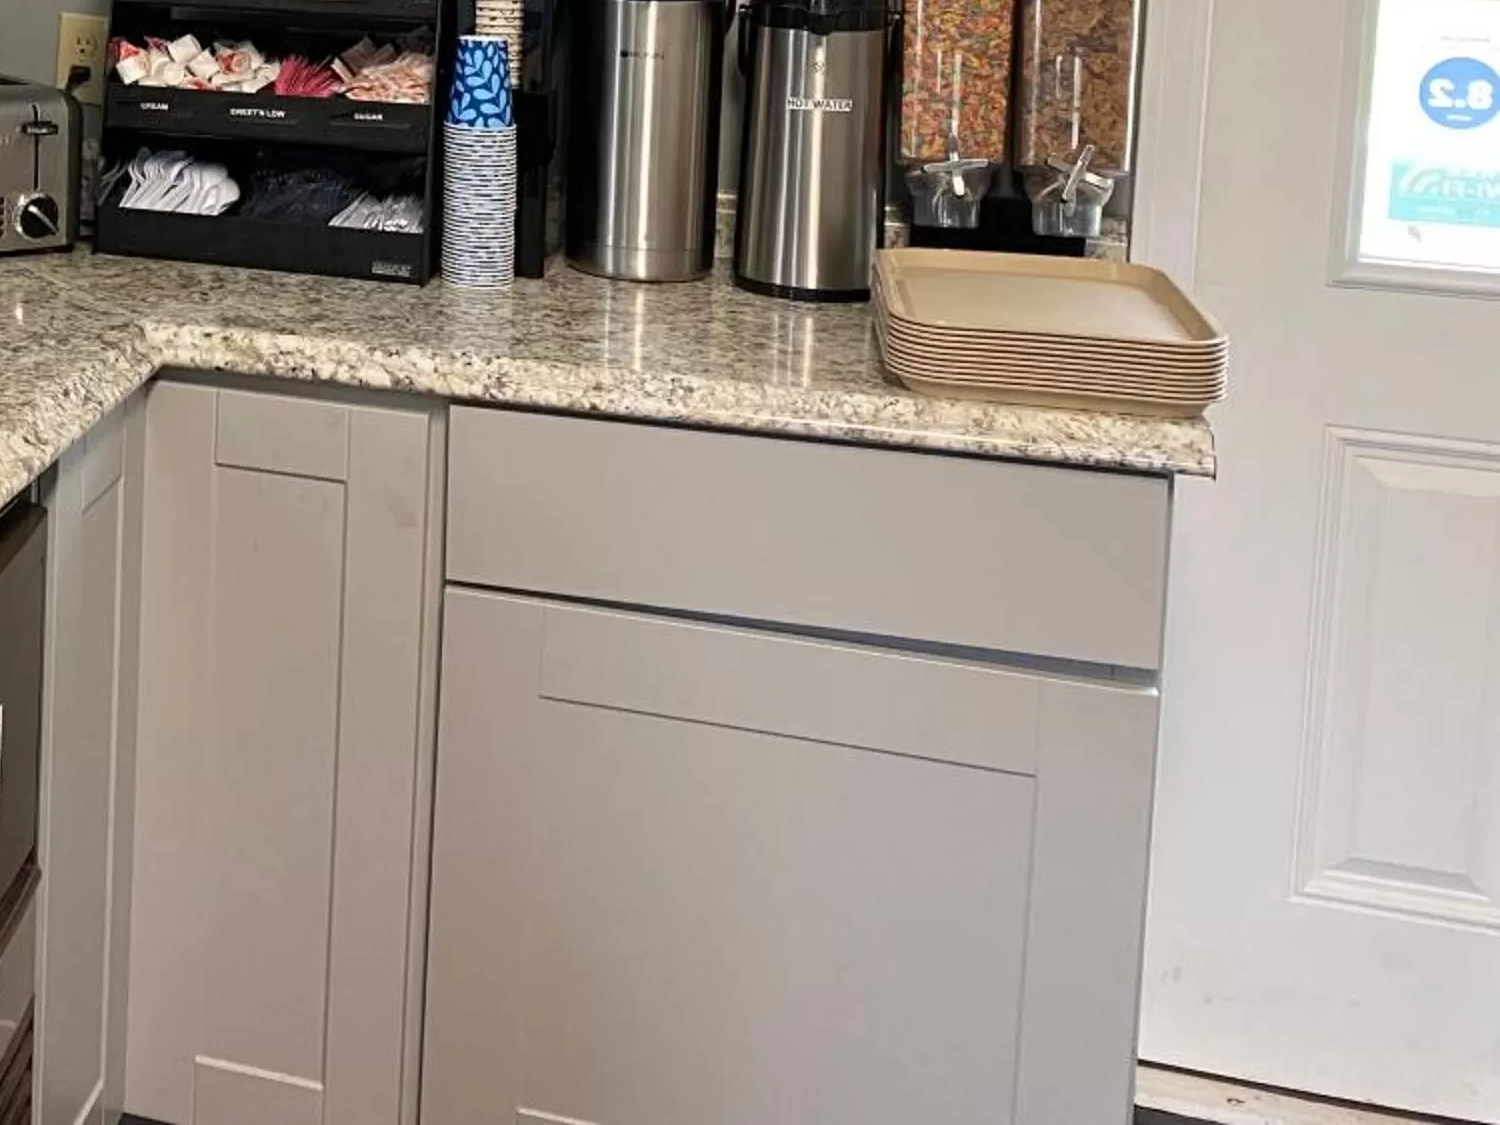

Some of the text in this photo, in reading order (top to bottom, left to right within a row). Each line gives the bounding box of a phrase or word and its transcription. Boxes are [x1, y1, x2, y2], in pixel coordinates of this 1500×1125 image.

[787, 98, 852, 111] HOT WATER
[266, 109, 287, 119] LOW
[353, 112, 383, 121] SUGAR
